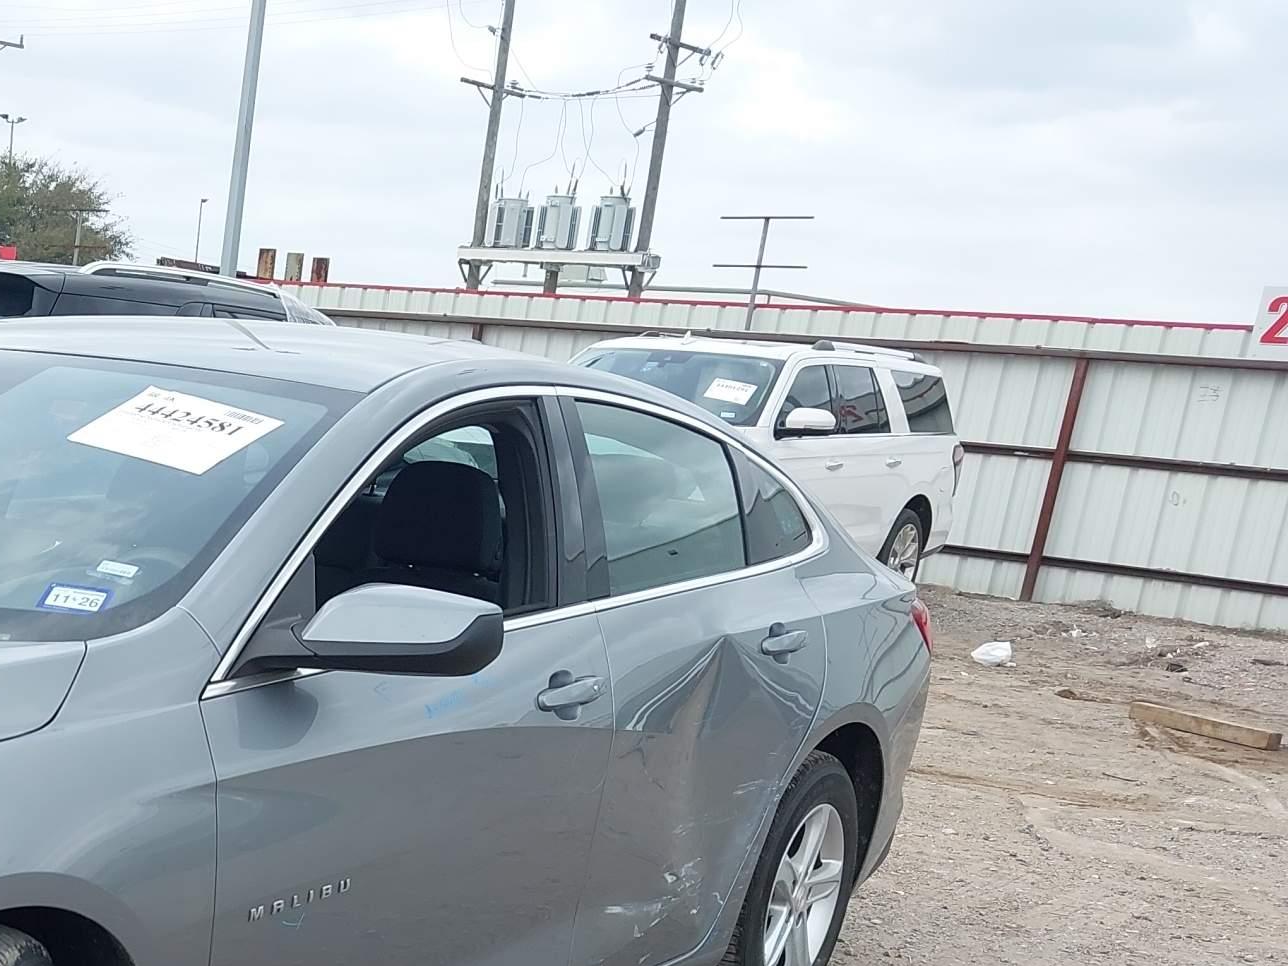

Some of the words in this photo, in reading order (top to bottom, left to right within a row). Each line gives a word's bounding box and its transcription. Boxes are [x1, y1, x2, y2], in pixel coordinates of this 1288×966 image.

[1259, 296, 1288, 345] 2
[134, 402, 245, 437] 44424581
[249, 878, 352, 922] MALIBU
